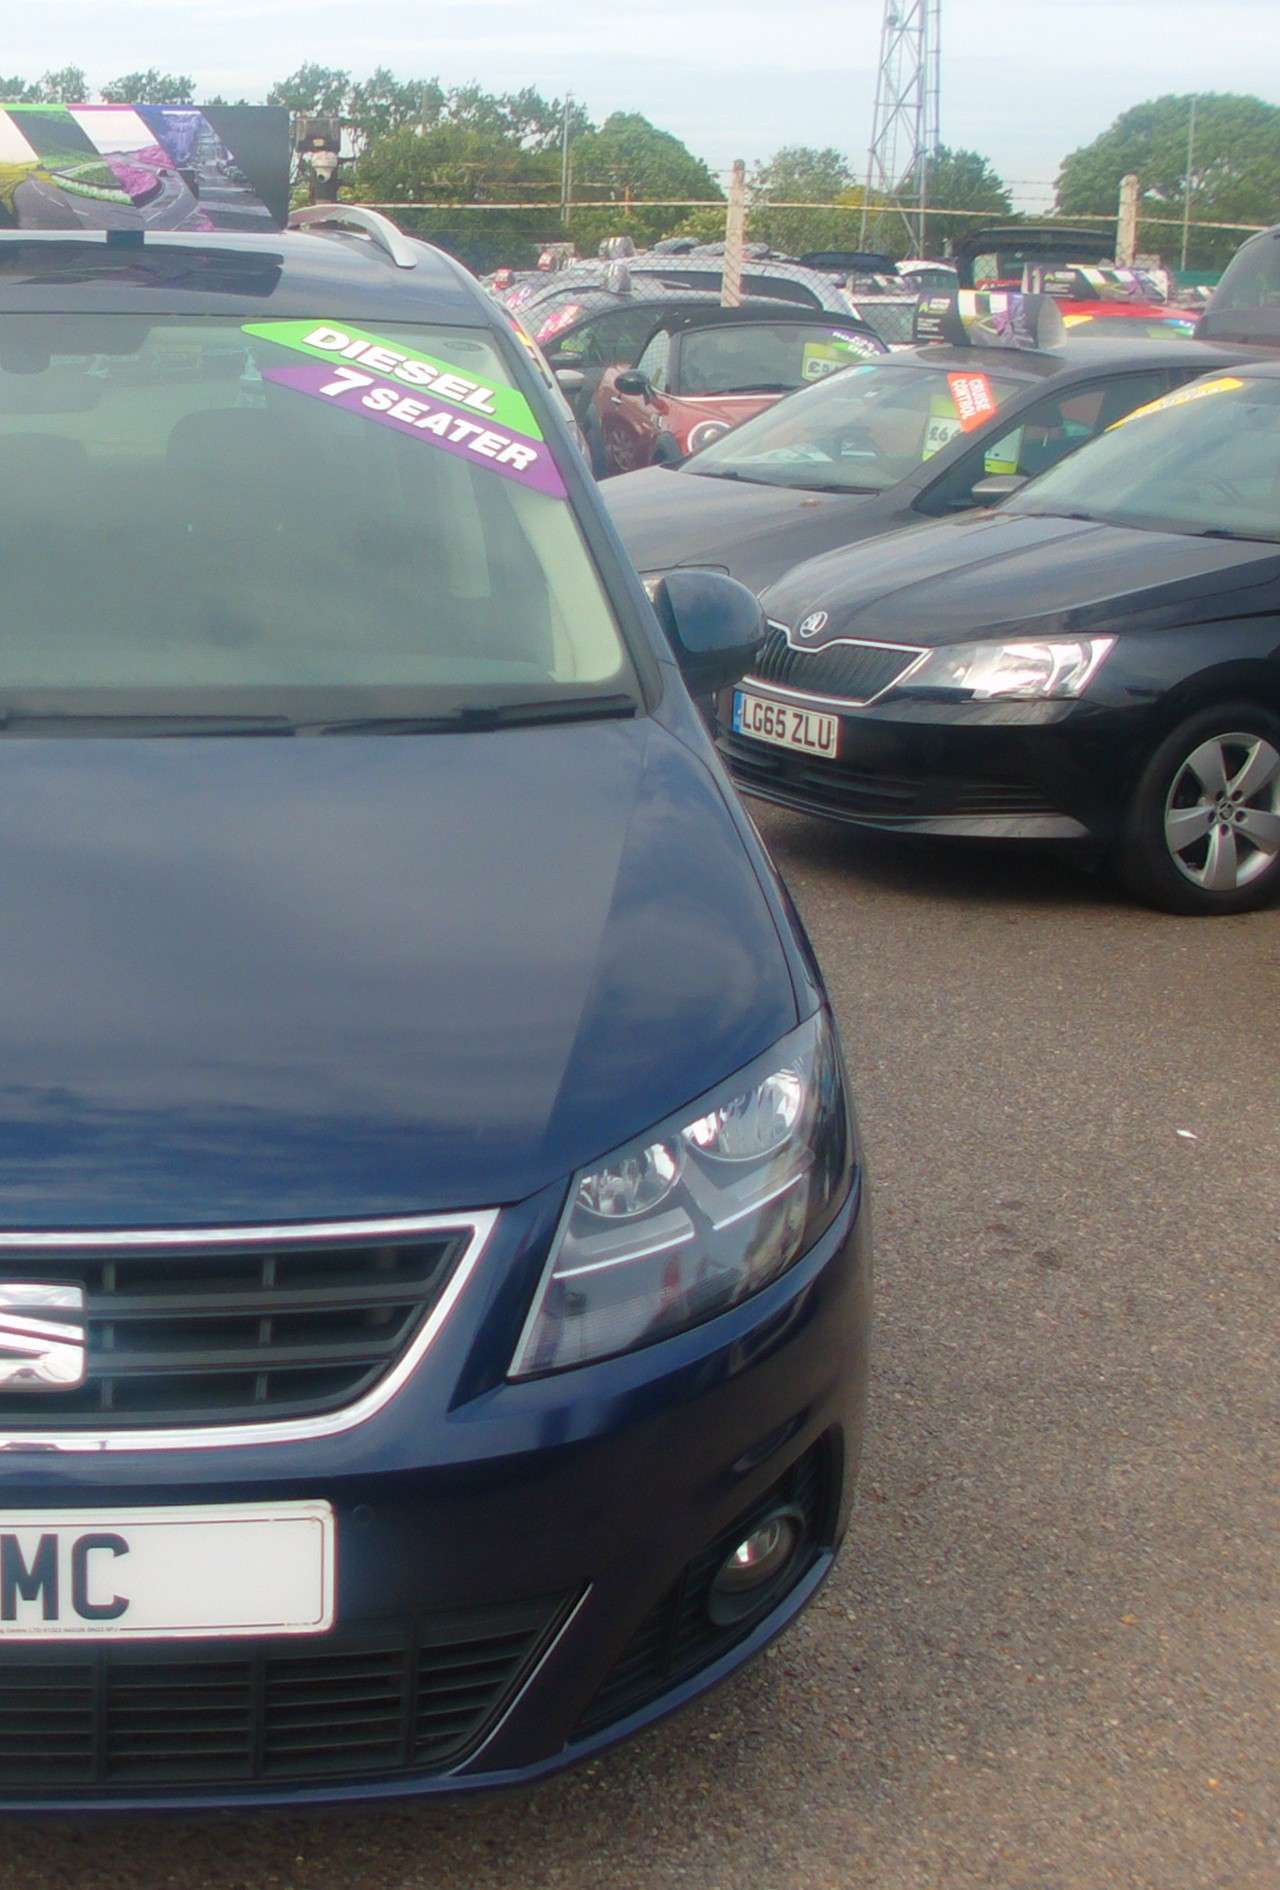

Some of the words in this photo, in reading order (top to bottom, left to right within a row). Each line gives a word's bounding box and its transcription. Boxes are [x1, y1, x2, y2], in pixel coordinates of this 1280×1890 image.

[301, 326, 497, 414] DIESEL
[968, 378, 993, 411] CRUISE
[319, 366, 375, 397] 7
[361, 387, 538, 471] SEATER
[951, 379, 977, 420] CONTROL
[742, 698, 787, 739] LG65
[790, 712, 832, 751] ZLU
